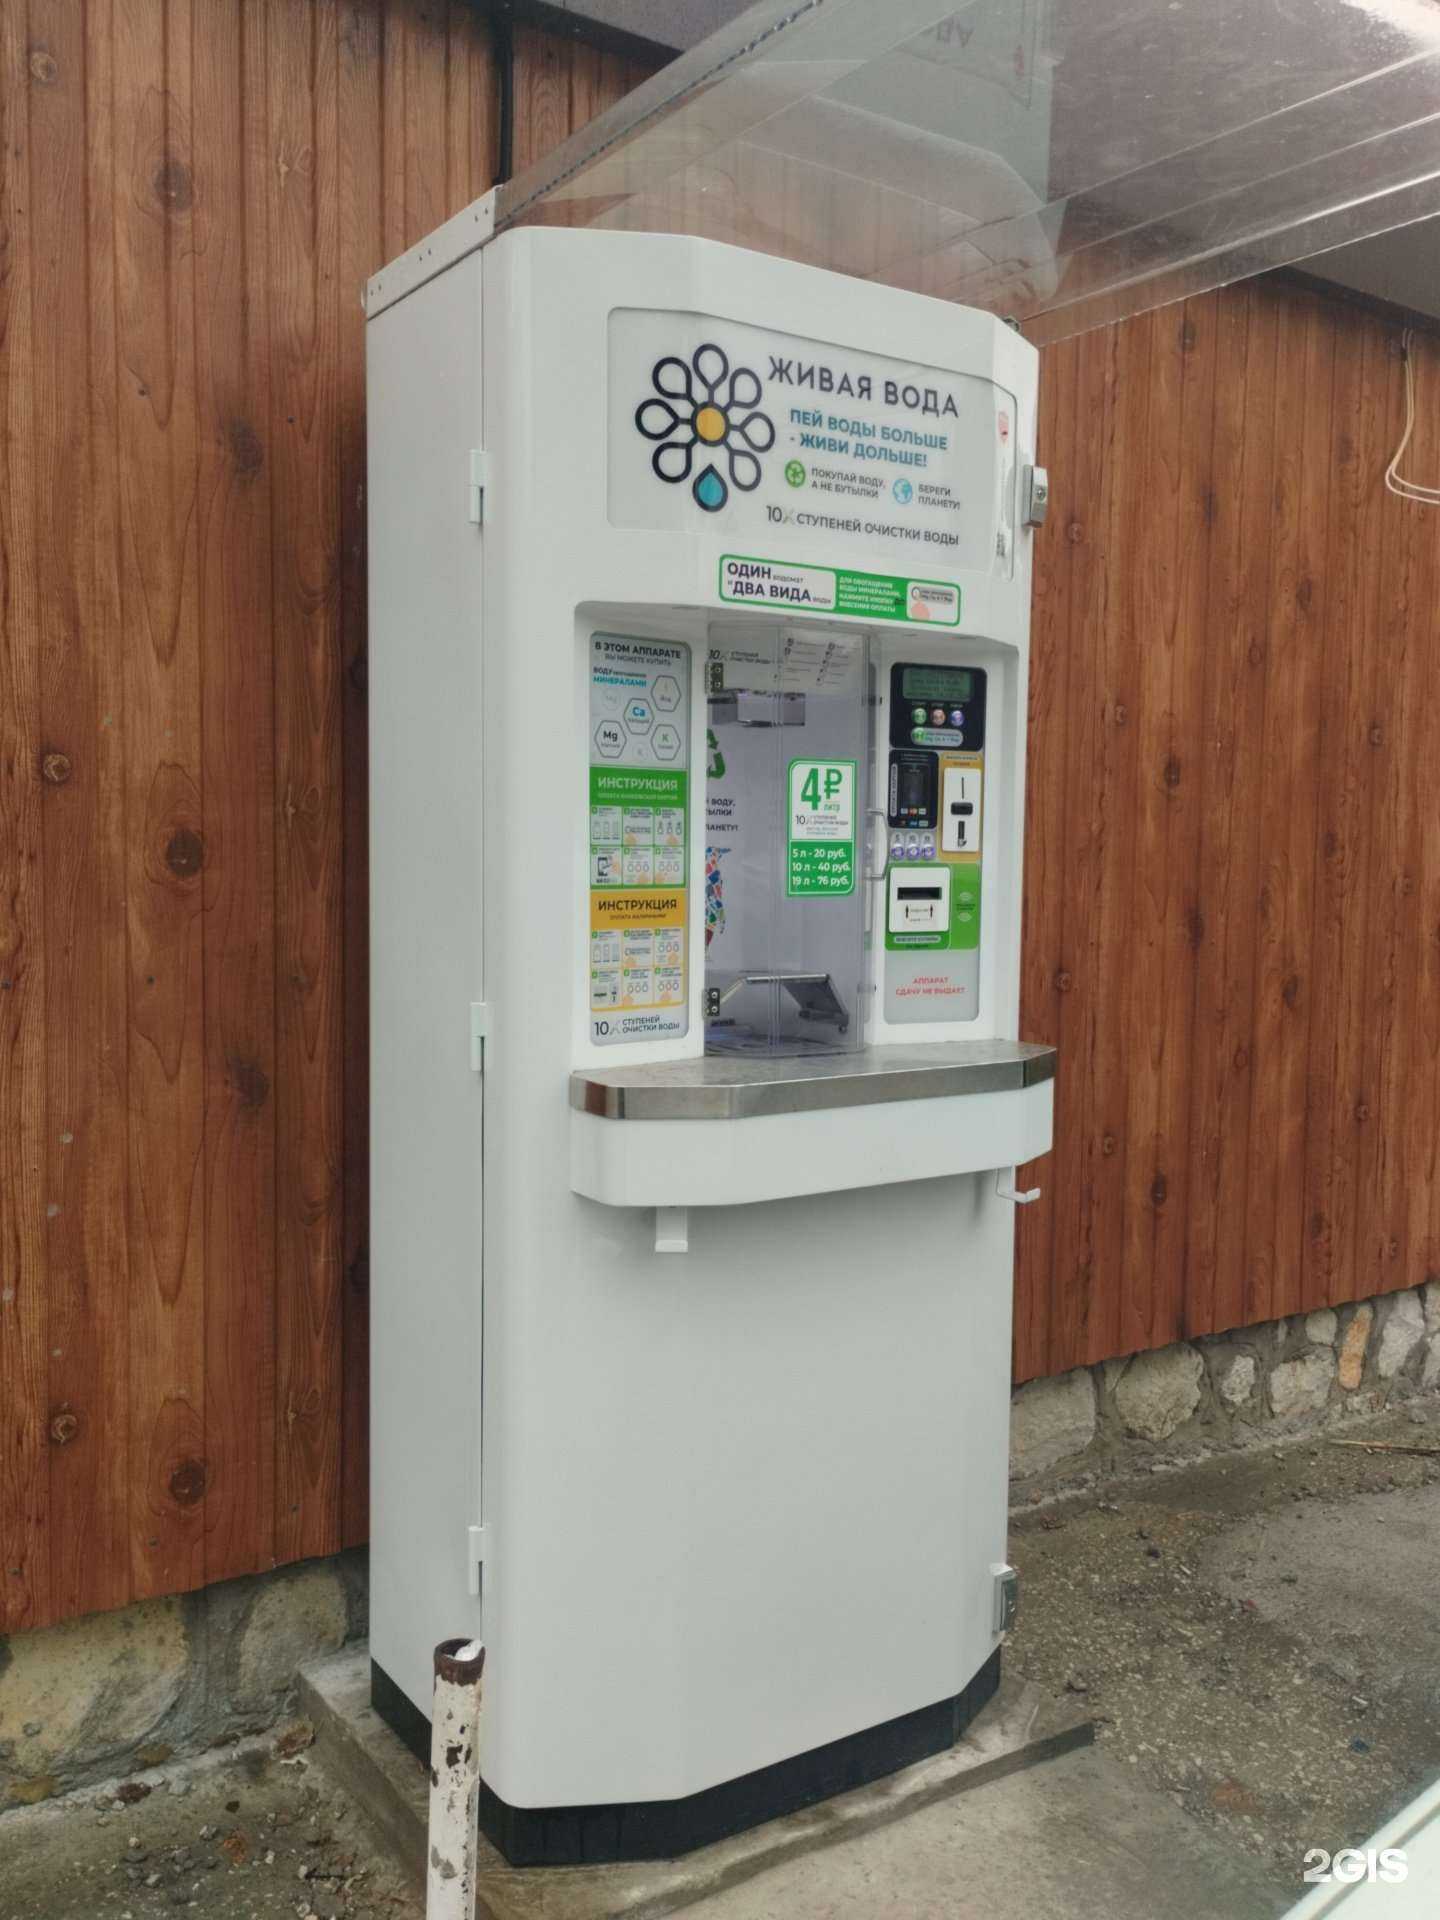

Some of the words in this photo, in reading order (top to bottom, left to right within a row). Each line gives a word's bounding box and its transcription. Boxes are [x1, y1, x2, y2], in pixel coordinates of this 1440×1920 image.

[768, 355, 872, 401] ЖИВАЯ
[884, 380, 959, 418] ВОДА
[790, 408, 823, 429] ПЕЙ
[828, 416, 877, 438] ВОДЫ
[881, 426, 948, 450] БОЛЬШЕ
[800, 432, 850, 455] ЖИВИ
[853, 443, 928, 468] ДОЛЬШЕ!
[811, 467, 857, 484] ПОКУПАЙ
[811, 480, 818, 489] А
[820, 482, 833, 492] НЕ
[835, 485, 879, 499] БУТЫЛКИ
[918, 484, 951, 497] БЕРЕГИ
[766, 505, 783, 523] 10
[797, 511, 862, 533] СТУПЕНЕЙ
[865, 522, 921, 541] ОЧИСТКИ
[924, 530, 959, 546] ВОДЫ
[727, 562, 771, 580] ОДИН
[733, 581, 766, 596] ДВА
[770, 585, 811, 602] ВИДА
[595, 642, 601, 651] В
[604, 642, 630, 654] ЭТОМ
[632, 645, 681, 659] АППАРАТЕ
[632, 706, 646, 717] Ca
[603, 730, 618, 742] Mg
[598, 776, 678, 792] ИНСТРУКЦИЯ
[792, 849, 798, 858] 5
[814, 849, 825, 858] 20
[827, 849, 846, 860] руб.
[792, 862, 802, 871] 10
[818, 862, 830, 871] 40
[832, 862, 850, 874] руб.
[792, 877, 801, 886] 19
[817, 876, 829, 886] 76
[830, 876, 849, 888] руб.
[598, 899, 677, 911] ИНСТРУКЦИЯ
[622, 1014, 660, 1025] СТУПЕНЕЙ
[594, 1020, 609, 1036] 10
[622, 1023, 657, 1034] ОЧИСТКИ
